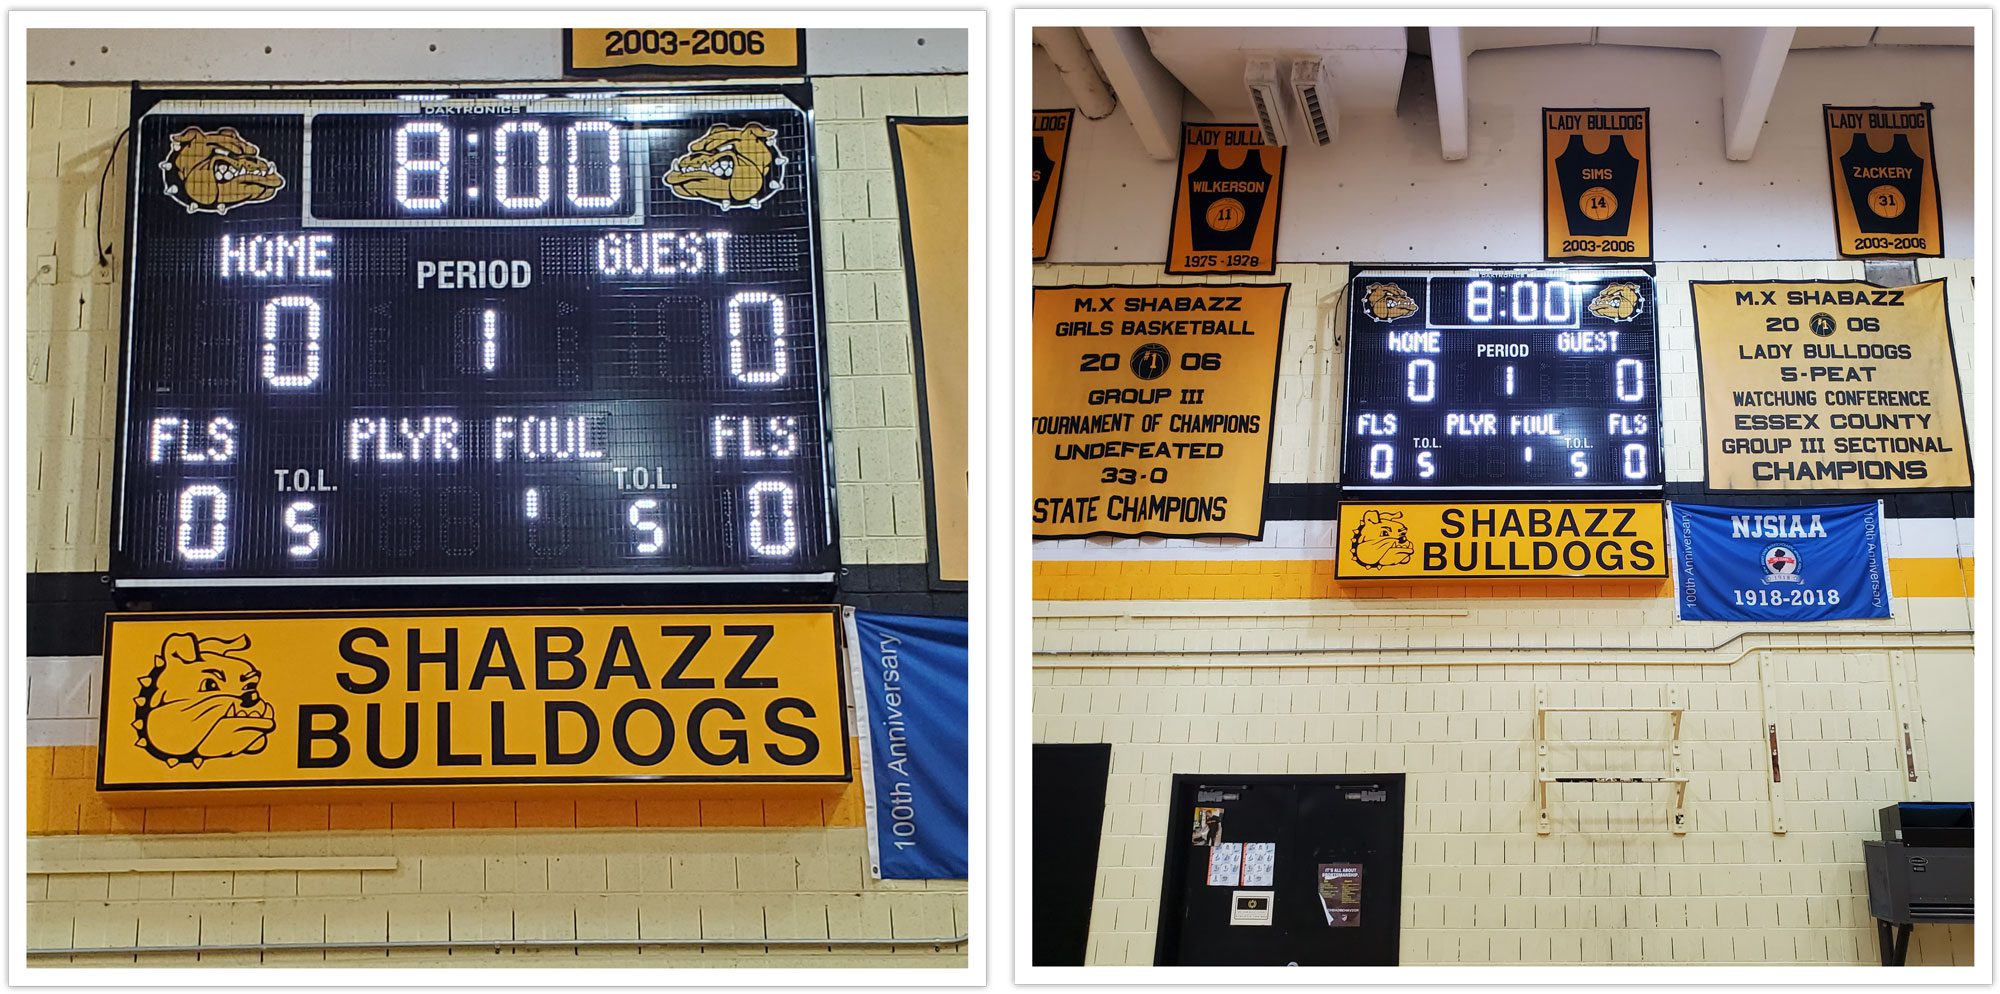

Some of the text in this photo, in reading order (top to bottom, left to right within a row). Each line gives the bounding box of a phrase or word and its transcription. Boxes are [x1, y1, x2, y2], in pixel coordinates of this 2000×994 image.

[605, 30, 765, 58] 2003-2006
[424, 106, 521, 115] DAKTRONICS
[1830, 113, 1925, 129] LADY BULLDOG
[1549, 114, 1644, 130] LADY BULLDOG
[1187, 129, 1221, 145] LADY
[396, 120, 621, 209] 8:00
[1582, 168, 1613, 181] SIMS
[1853, 166, 1913, 180] ZACKERY
[1192, 181, 1265, 193] WILKERSON
[1591, 197, 1606, 209] 14
[1878, 194, 1896, 207] 31
[1218, 209, 1232, 221] 11
[598, 231, 732, 275] GUEST
[1562, 239, 1635, 253] 2003-2006
[1854, 237, 1926, 251] 2003-2006
[219, 234, 333, 278] HOME
[416, 260, 532, 290] PERIOD
[1074, 296, 1242, 312] M.X SHABAZZ
[1467, 280, 1570, 322] 8:00
[1735, 290, 1905, 306] M.X SHABAZZ
[1055, 320, 1255, 337] GIRLS BASKETBALL
[1765, 317, 1800, 332] 20
[1847, 317, 1880, 332] 06
[262, 296, 320, 387] 0
[484, 308, 496, 372] 1
[728, 291, 786, 384] 0
[1389, 331, 1441, 353] HOME
[1557, 331, 1619, 352] GUEST
[1477, 343, 1529, 358] PERIOD
[1739, 344, 1912, 360] LADY BULLDOGS
[1080, 353, 1121, 372] 20
[1180, 353, 1222, 371] 06
[1407, 358, 1435, 401] 0
[1505, 366, 1514, 395] 1
[1616, 358, 1644, 401] 0
[1780, 366, 1876, 382] 5-PEAT
[1088, 388, 1205, 406] GROUP III
[1733, 390, 1931, 407] WATCHUNG CONFERENCE
[1141, 413, 1163, 433] OF
[1169, 414, 1261, 434] CHAMPIONS
[1357, 414, 1398, 435] FLS
[1446, 413, 1562, 435] PLYR FOUL
[1608, 413, 1648, 434] FLS
[1735, 413, 1931, 430] ESSEX COUNTY
[150, 416, 236, 461] FLS
[350, 415, 603, 461] PLYR FOUL
[714, 414, 797, 458] FLS
[1413, 437, 1442, 449] T.O.L.
[1564, 437, 1594, 449] T.O.L.
[1722, 437, 1953, 454] GROUP III SECTIONAL
[1054, 441, 1224, 460] UNDEFEATED
[1370, 443, 1393, 479] 0
[1624, 443, 1647, 479] 0
[274, 469, 338, 492] T.O.L.
[613, 467, 678, 490] T.O.L.
[1752, 460, 1928, 481] CHAMPIONS
[748, 480, 796, 556] 0
[1032, 495, 1228, 524] STATE CHAMPIONS
[178, 484, 228, 559] 0
[1440, 508, 1637, 538] SHABAZZ
[1730, 514, 1827, 538] NJSIAA
[1423, 540, 1656, 571] BULLDOGS
[1681, 511, 1697, 608] 100th Anniversary
[1863, 511, 1883, 609] 100th Anniversary
[1733, 589, 1840, 606] 1918-2018
[336, 624, 779, 694] SHABAZZ
[297, 697, 820, 769] BULLDOGS
[876, 631, 917, 851] 100th Anniversary
